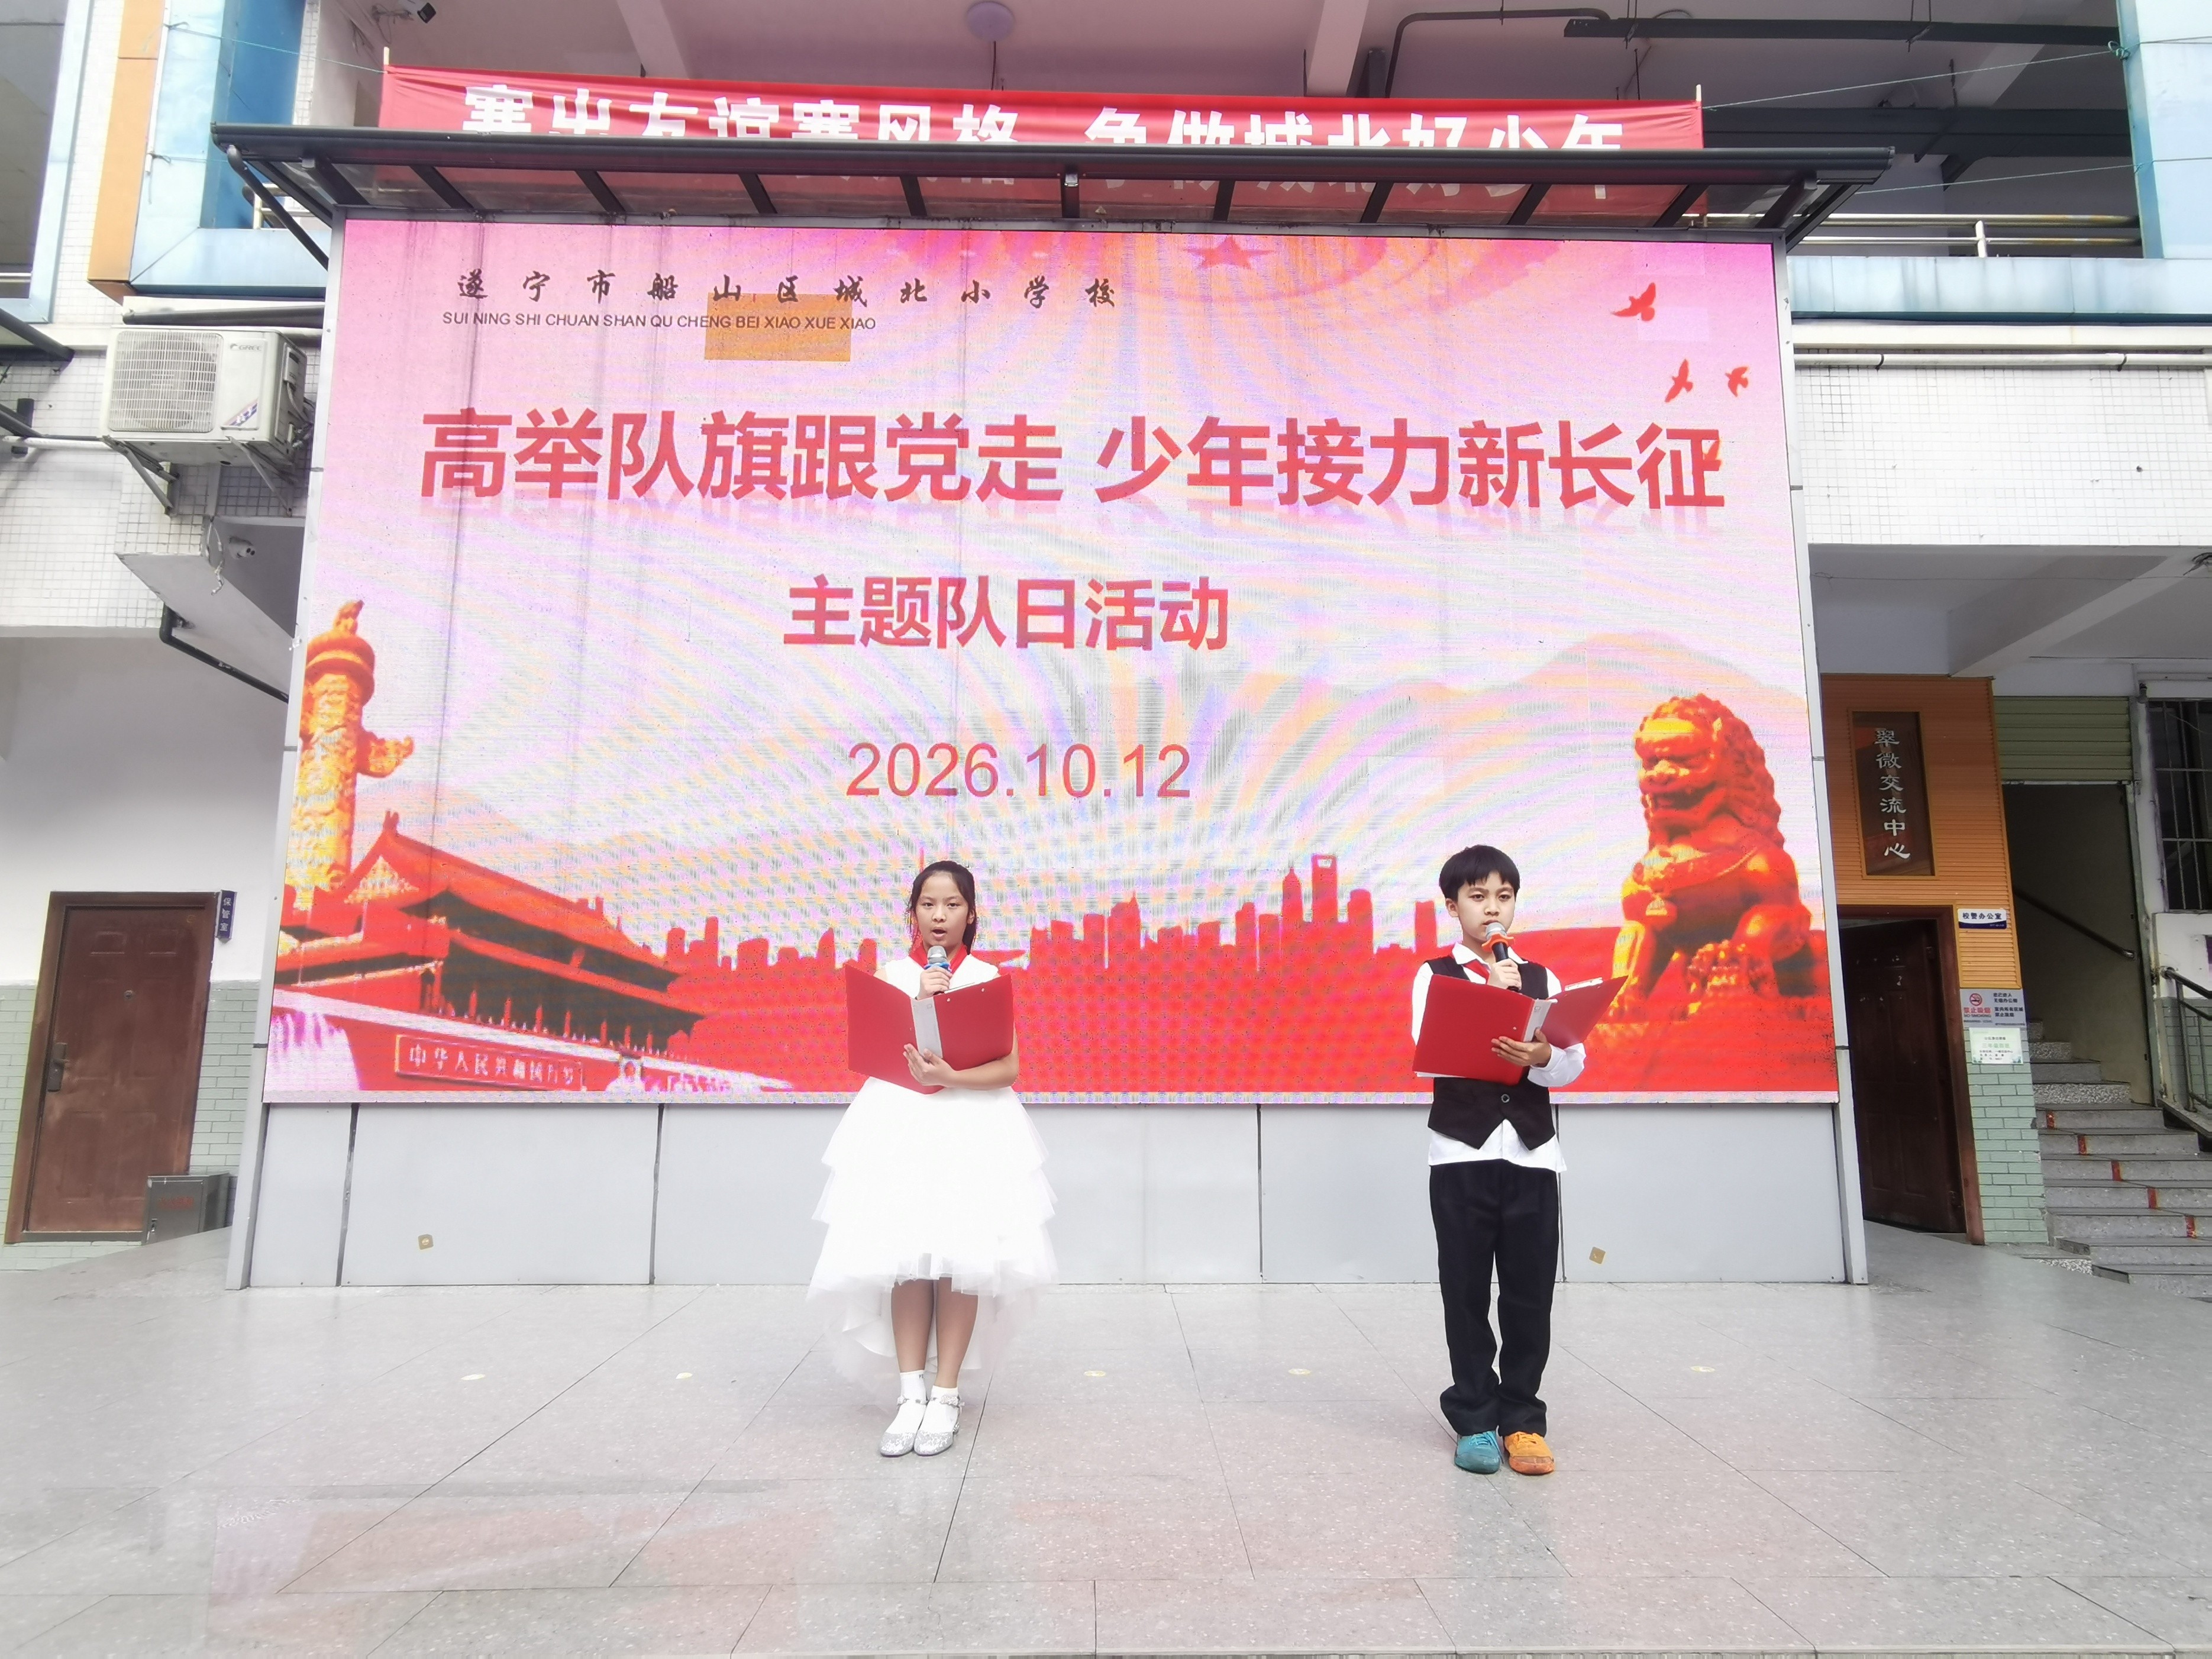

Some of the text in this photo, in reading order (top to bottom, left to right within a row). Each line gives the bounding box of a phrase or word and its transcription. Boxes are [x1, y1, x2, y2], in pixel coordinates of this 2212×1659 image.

[457, 269, 1116, 308] 遂宁市船山区城北小学校
[443, 312, 876, 330] SUI NING SHI CHUAN SHAN QU CHENG BEI XIAO XUE XIAO
[421, 408, 1725, 509] 高举队旗跟党走 少年接力新长征
[783, 574, 1228, 650] 主题队日活动
[847, 743, 1190, 798] 2026.10.12
[1874, 728, 1911, 859] 翠微交流中心
[219, 897, 231, 931] 保管室
